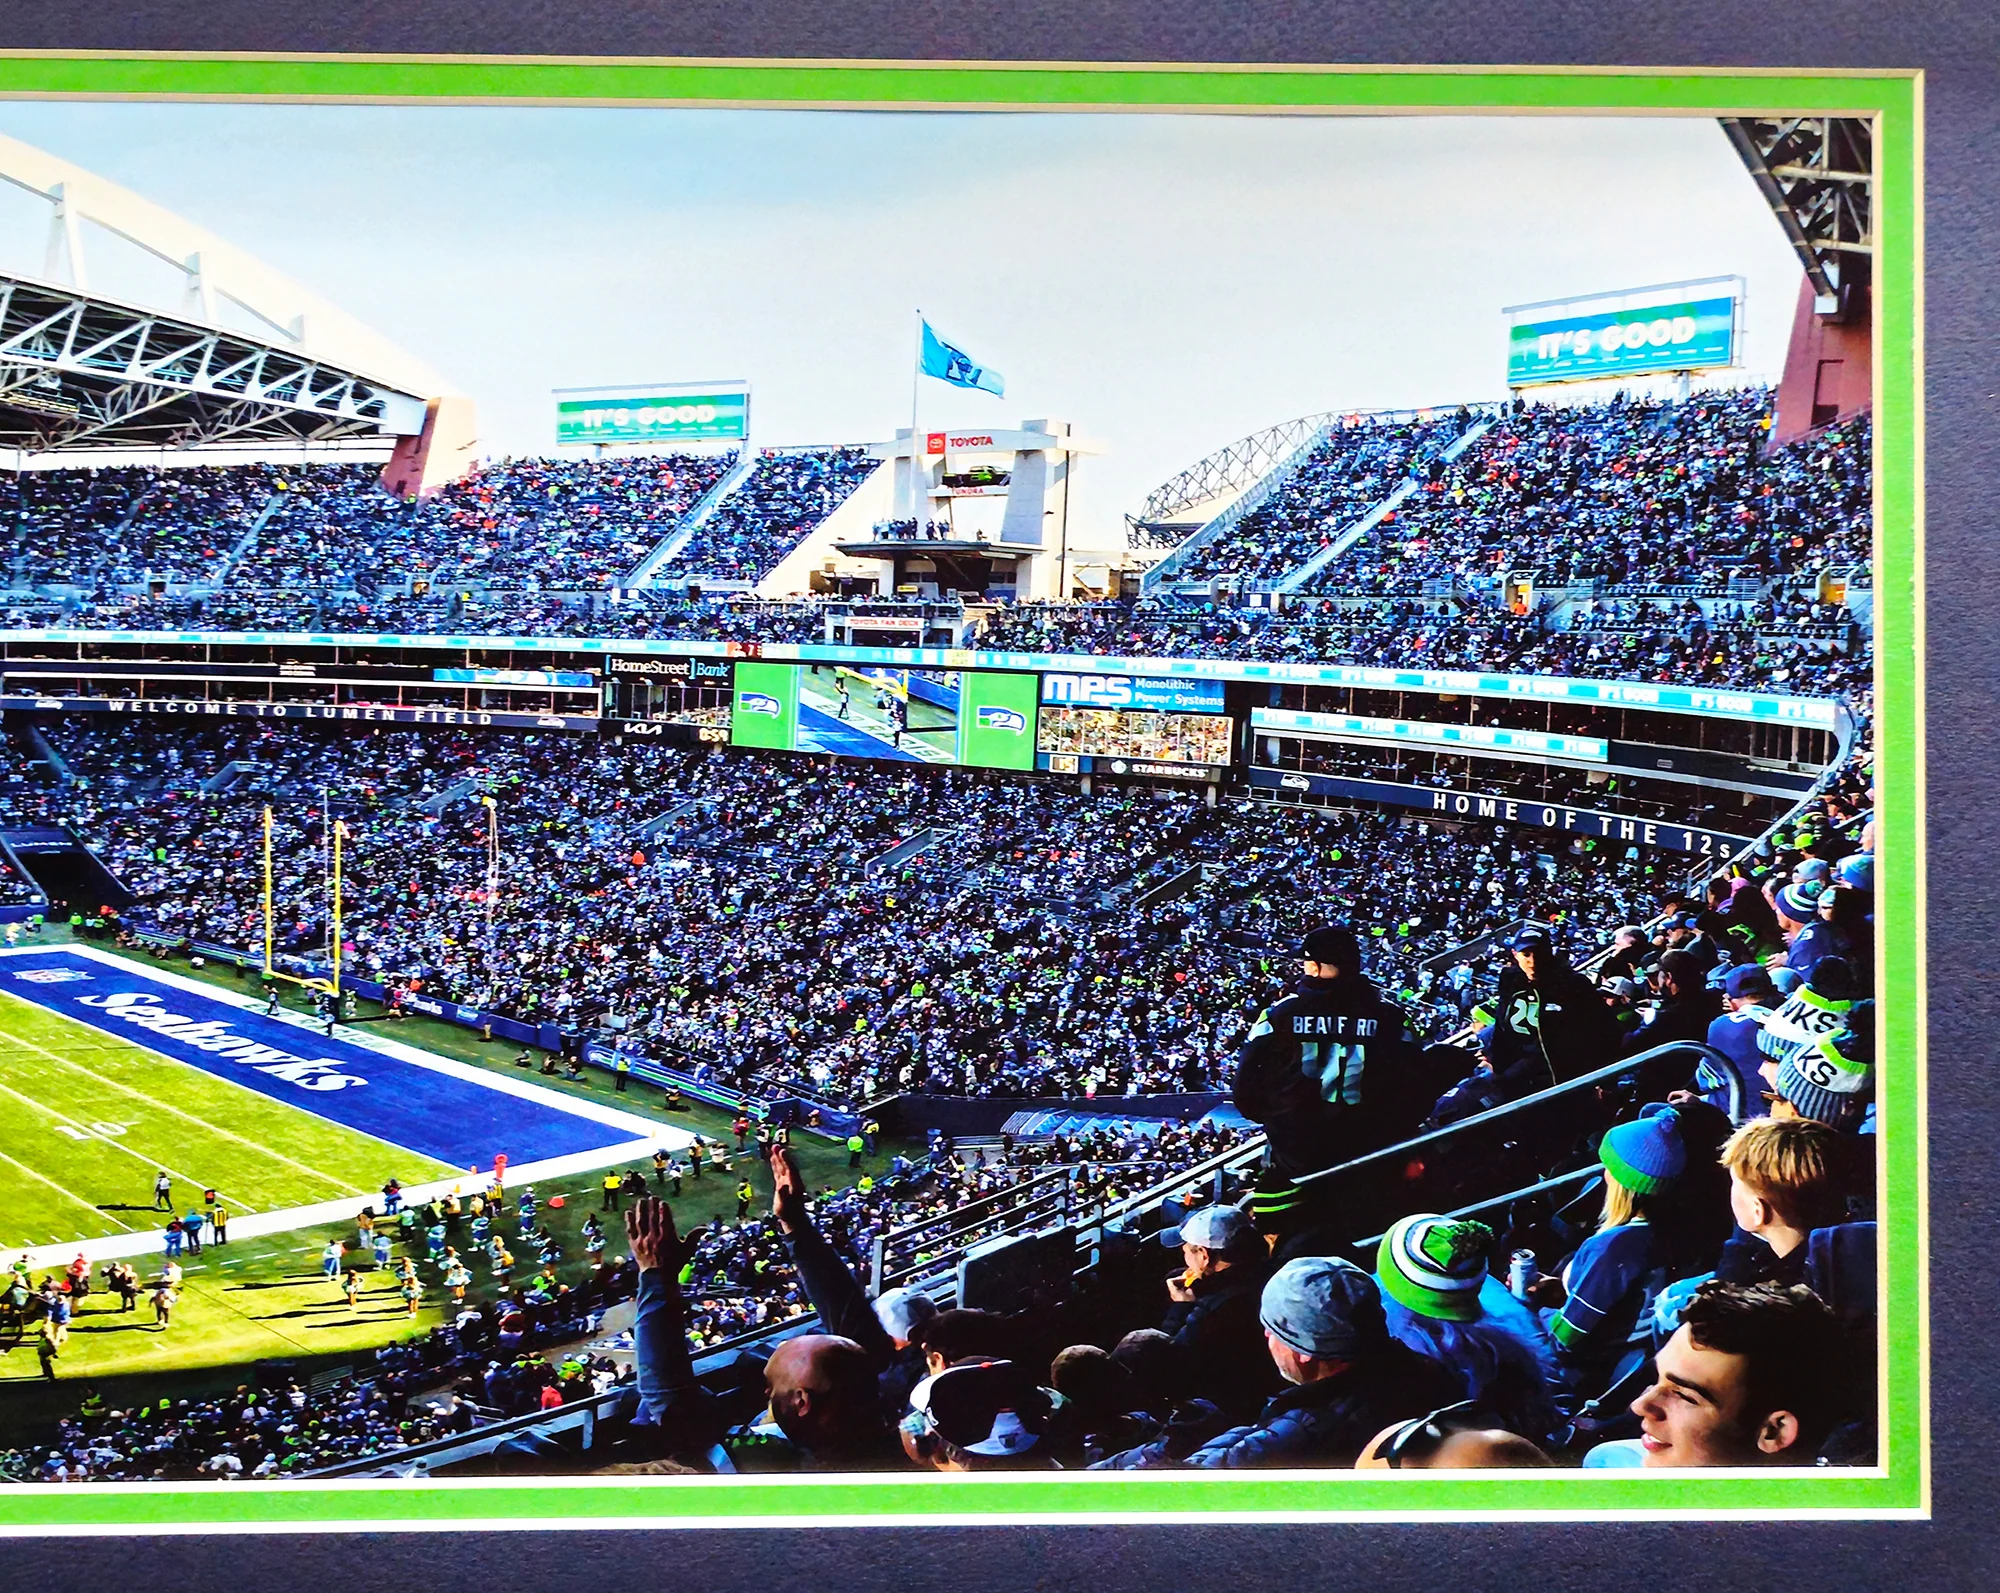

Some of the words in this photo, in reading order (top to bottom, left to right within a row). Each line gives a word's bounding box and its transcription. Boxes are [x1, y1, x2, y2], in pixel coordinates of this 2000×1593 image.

[1537, 329, 1591, 359] IT'S
[1599, 316, 1696, 352] GOOD
[584, 408, 630, 428] IT'S
[637, 405, 716, 425] GOOD
[950, 436, 993, 447] TOYOTA
[952, 486, 984, 495] TUNDRA
[850, 618, 878, 626] TOYOTA
[898, 619, 919, 627] DECK
[697, 662, 728, 677] Bank
[1044, 674, 1132, 704] MPS
[1135, 677, 1195, 691] Monolithic
[1135, 692, 1170, 703] Power
[1175, 693, 1225, 707] Systems
[109, 701, 238, 716] WELCOME
[256, 704, 287, 717] TO
[306, 706, 395, 721] LUMEN
[414, 711, 492, 726] FIELD
[1132, 763, 1207, 778] STARBUCKS
[1433, 792, 1519, 821] HOME
[1542, 807, 1577, 830] OF
[1598, 816, 1657, 845] THE
[1682, 831, 1731, 859] 12s
[74, 992, 369, 1092] Seahawks
